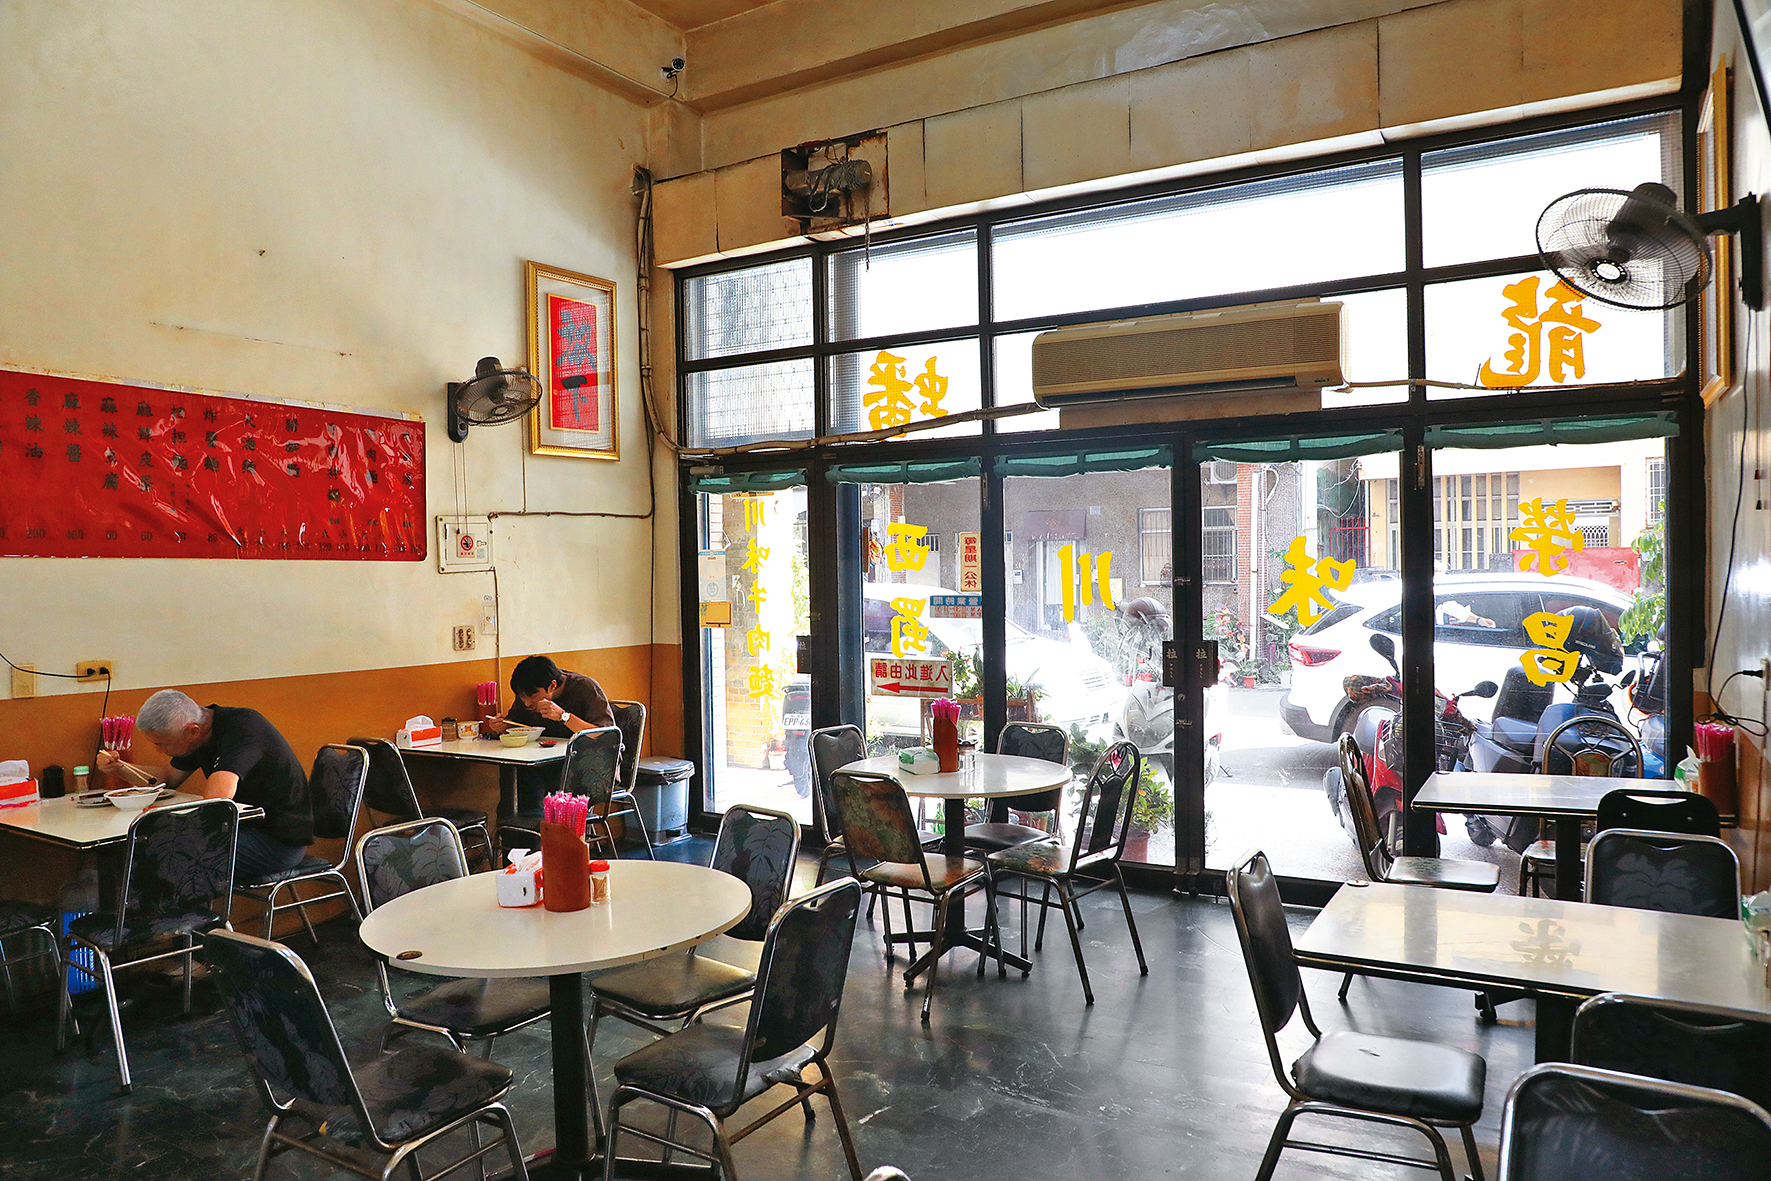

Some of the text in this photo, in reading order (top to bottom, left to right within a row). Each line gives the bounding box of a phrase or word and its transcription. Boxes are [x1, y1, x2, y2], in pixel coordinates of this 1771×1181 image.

[1166, 648, 1178, 660] 拉
[1195, 648, 1208, 660] 拉
[784, 717, 811, 726] EPP-63
